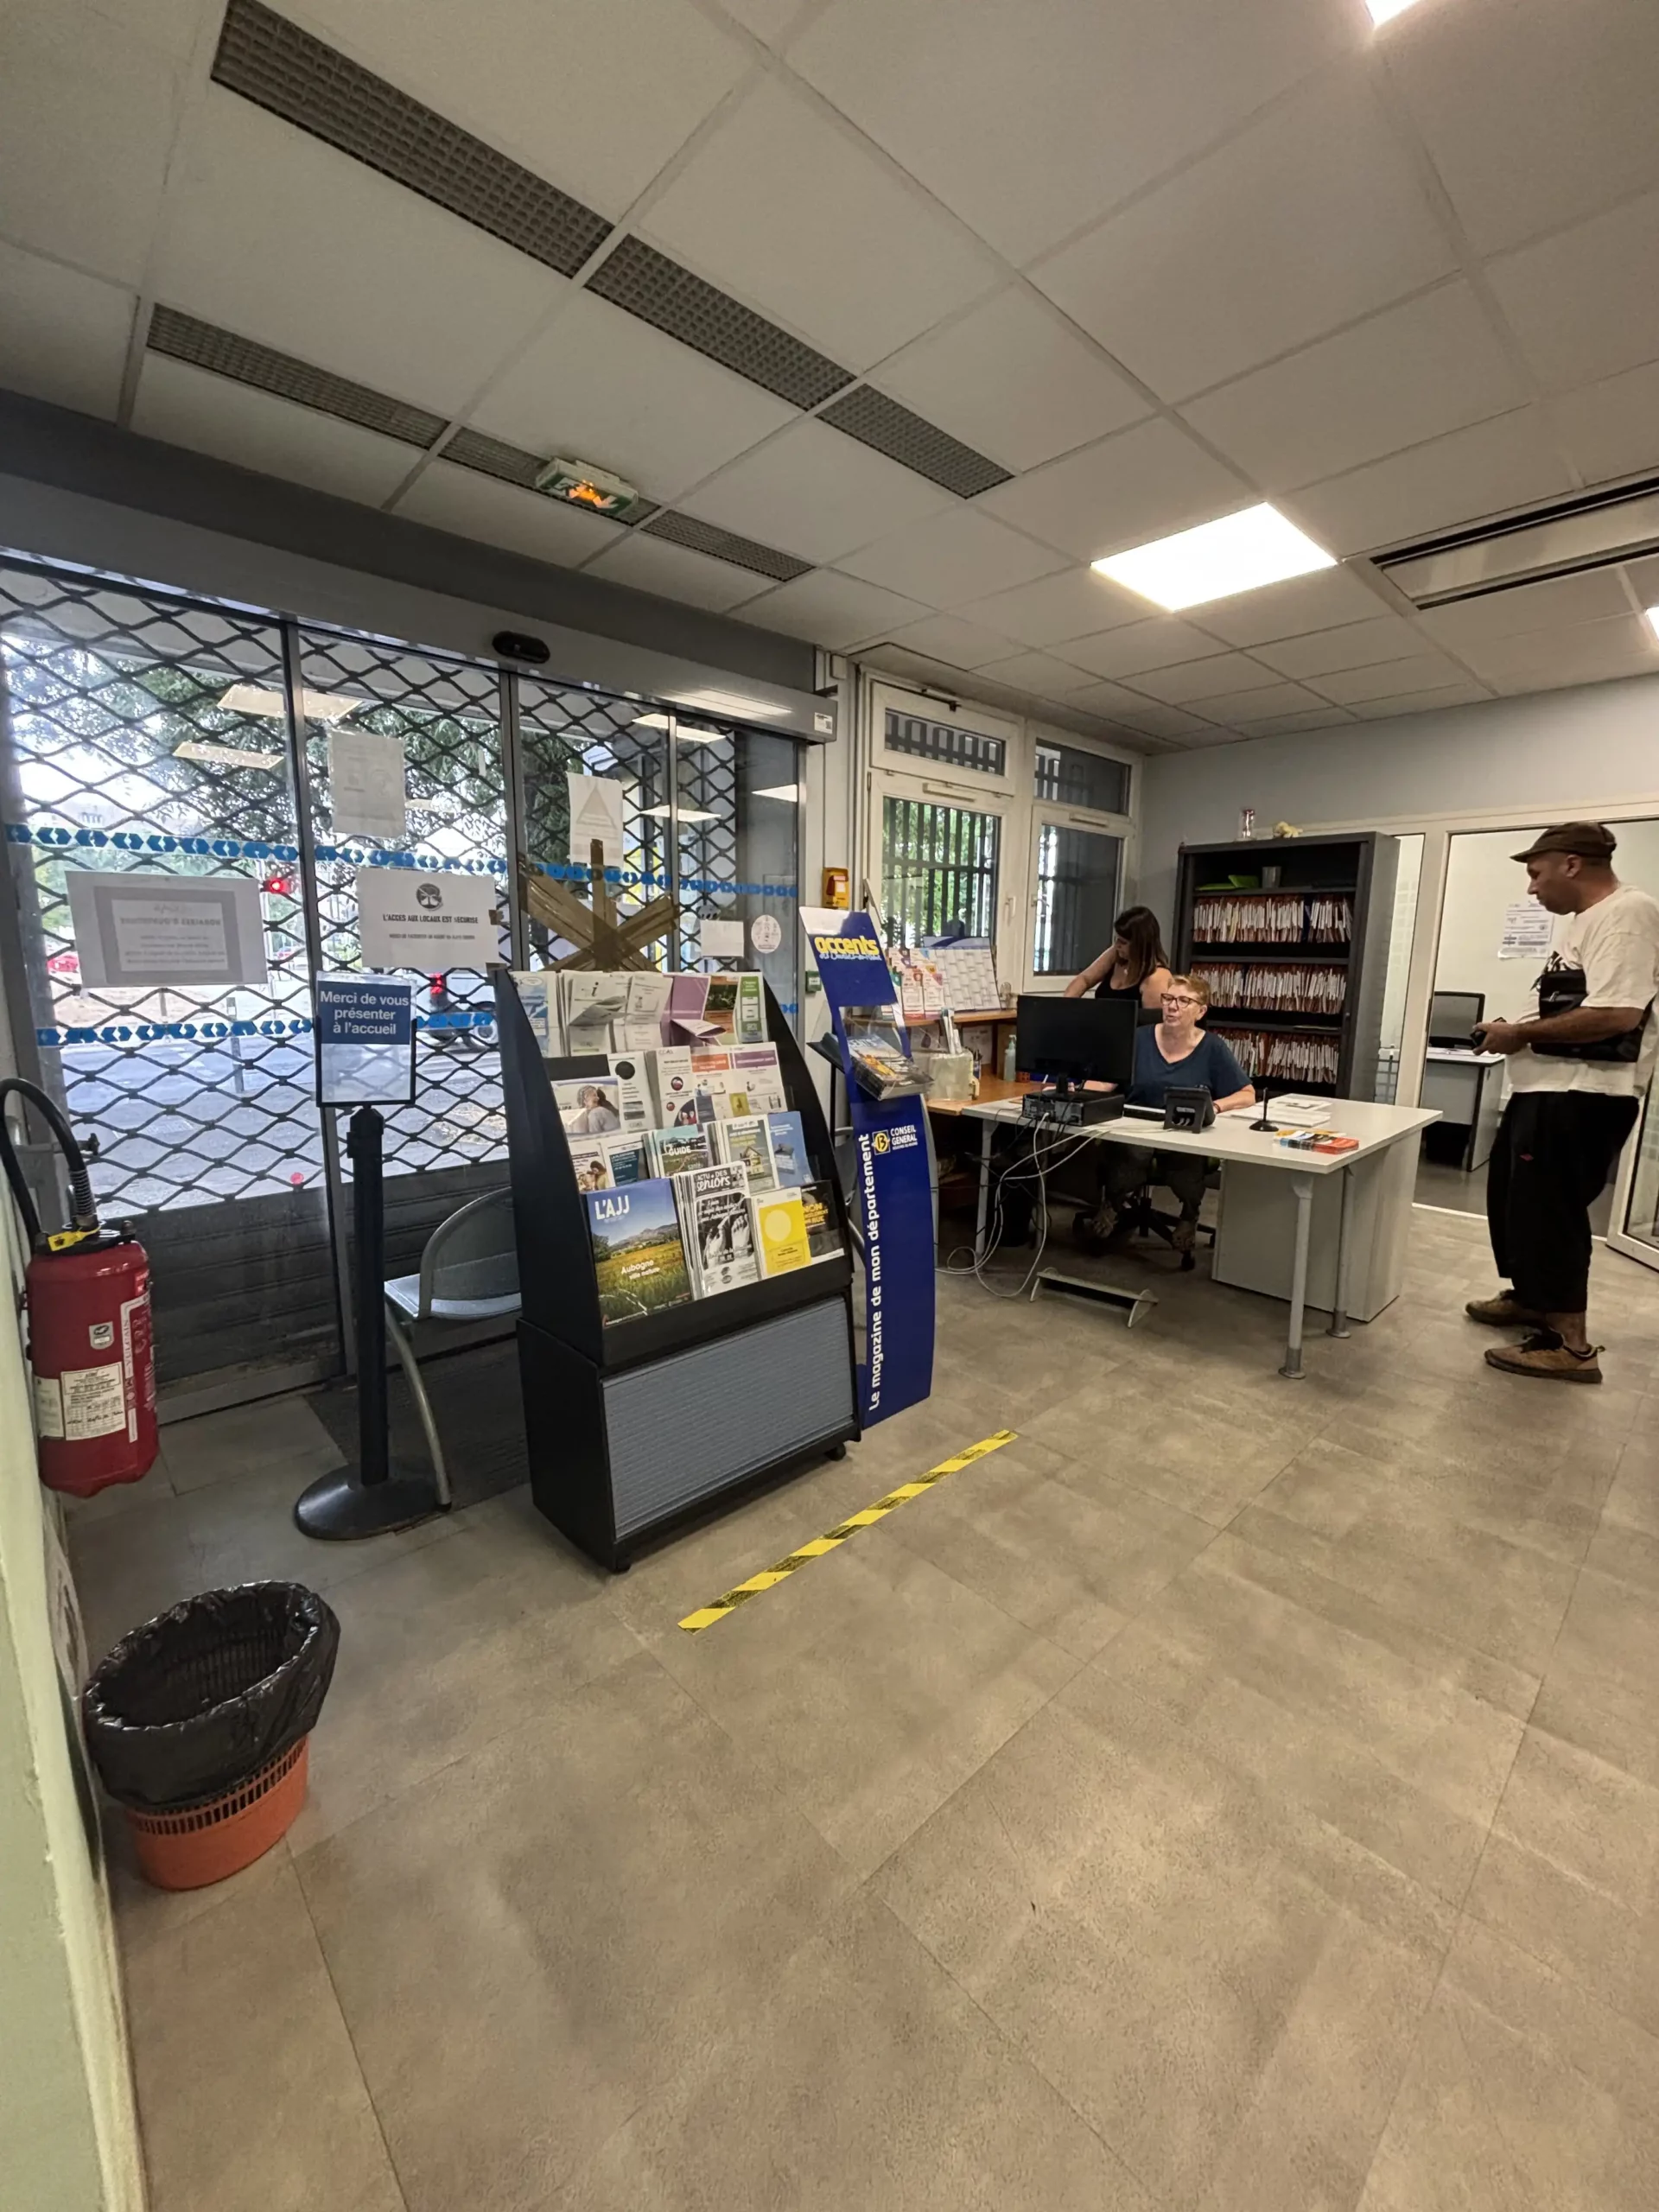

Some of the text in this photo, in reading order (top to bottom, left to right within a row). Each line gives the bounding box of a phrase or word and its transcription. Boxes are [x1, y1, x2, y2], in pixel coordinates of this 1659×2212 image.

[420, 914, 441, 923] LOCAUX
[814, 935, 880, 956] accents
[320, 990, 410, 1006] Merci de vous
[334, 1007, 397, 1020] présenter
[333, 1021, 397, 1035] à l'accueil
[890, 1124, 917, 1137] CONSEIL
[892, 1134, 918, 1146] GENERAL
[669, 1146, 692, 1156] GUIDE
[594, 1195, 630, 1220] L'AJJ
[620, 1259, 655, 1274] Aubagne
[858, 1134, 883, 1411] Le magazine de mon département
